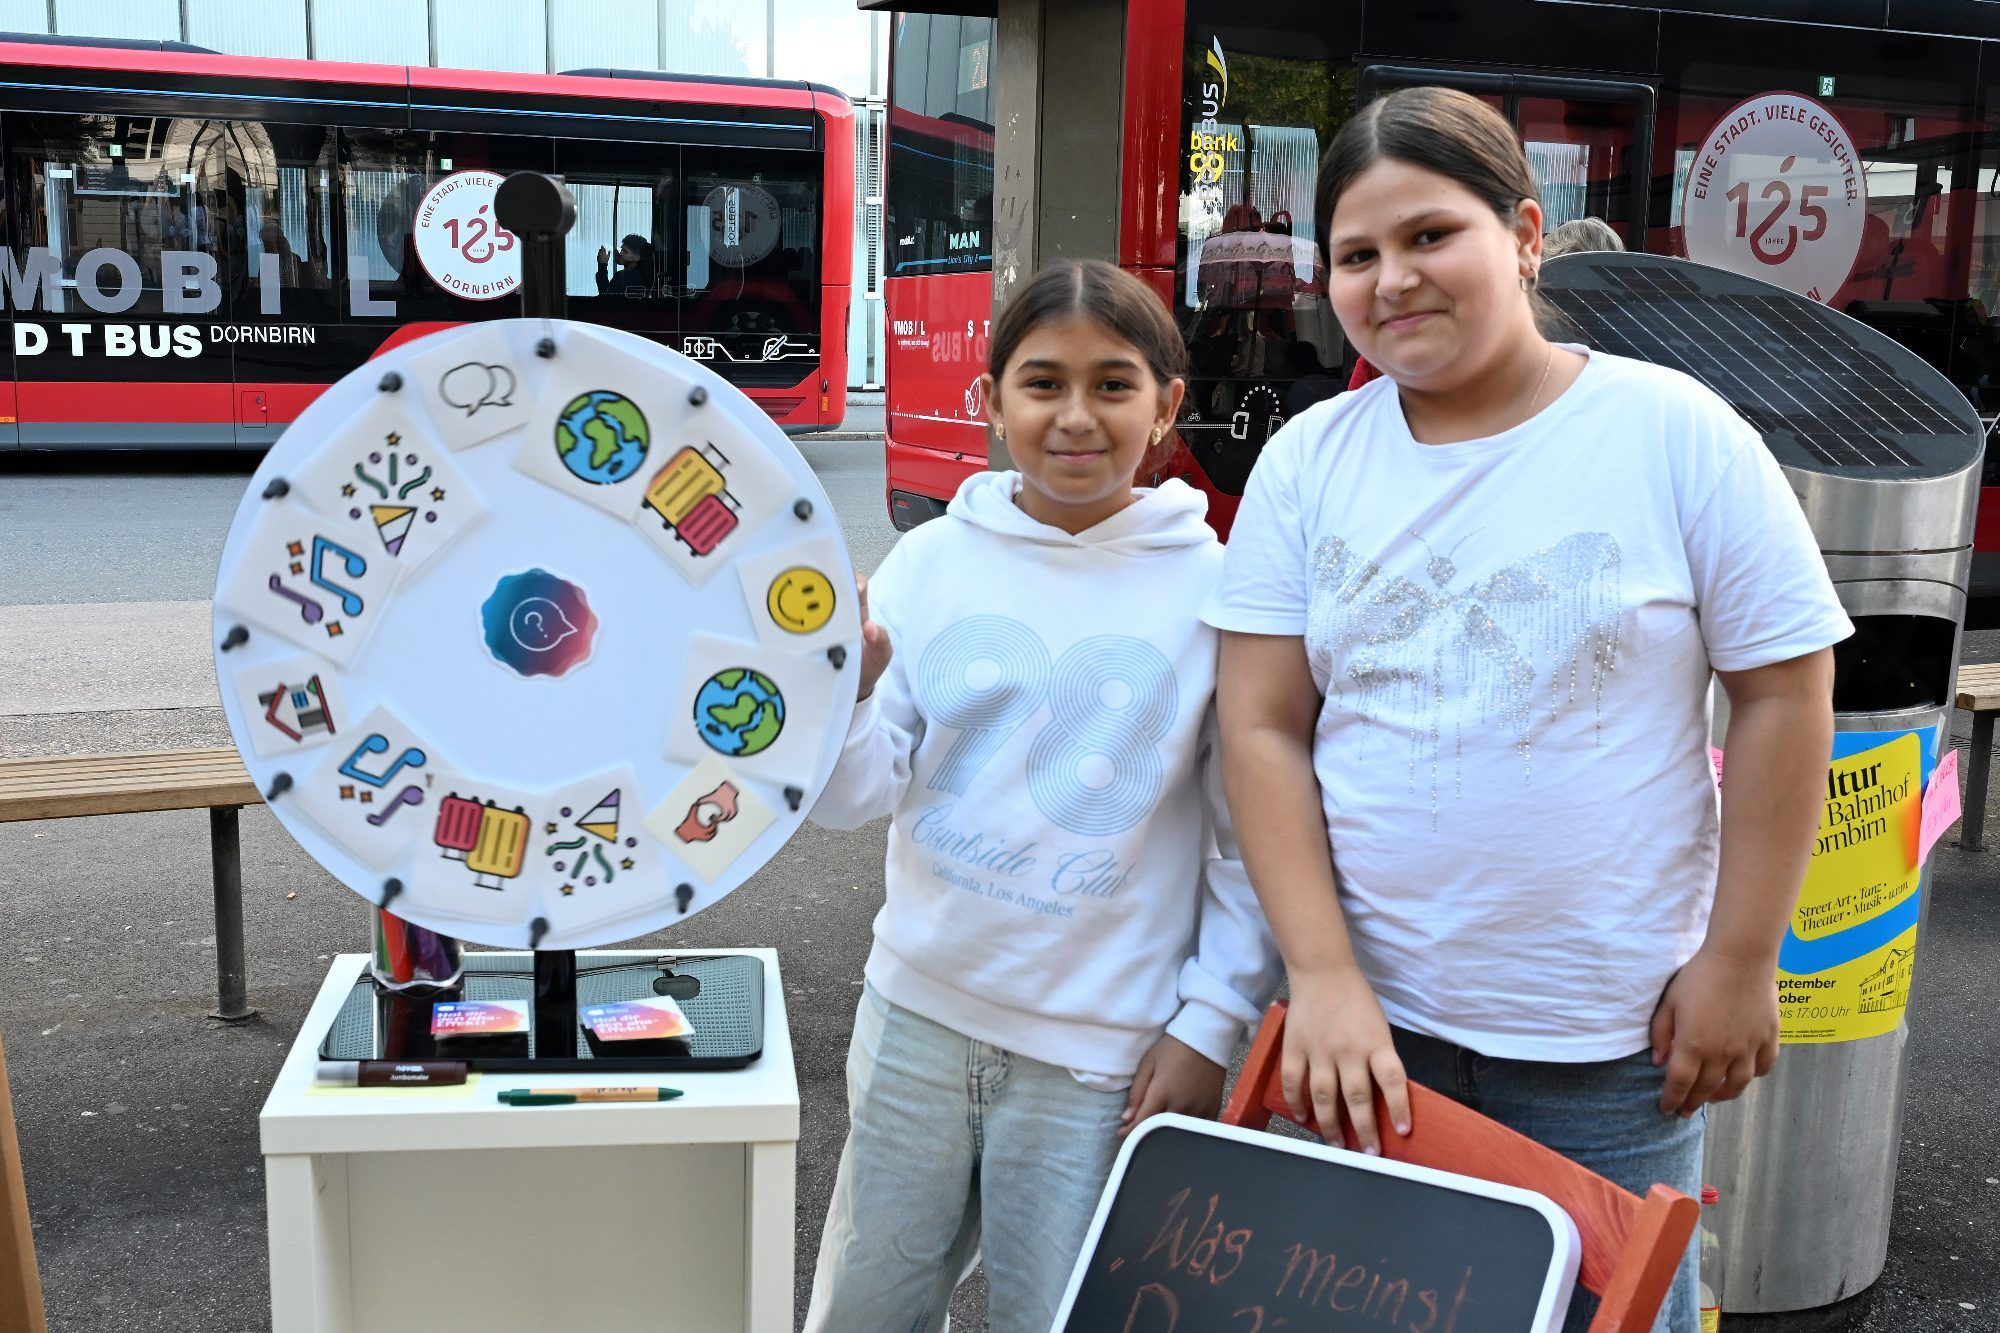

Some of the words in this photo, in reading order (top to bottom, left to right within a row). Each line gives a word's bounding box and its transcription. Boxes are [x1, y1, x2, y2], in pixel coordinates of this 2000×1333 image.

[1190, 130, 1239, 152] bank
[1694, 155, 1718, 200] EINE
[1765, 104, 1807, 124] VIELE
[1809, 115, 1858, 206] GESICHTER.
[421, 203, 436, 228] EINE
[464, 177, 494, 189] VIELE
[443, 217, 515, 264] 125
[949, 230, 980, 250] MAN
[1726, 180, 1829, 266] 125
[442, 273, 515, 295] DORNBIRN
[104, 324, 204, 359] BUS
[210, 325, 317, 345] DORNBIRN
[917, 615, 1179, 837] 98
[1827, 772, 1910, 827] Bahnhof
[911, 804, 1037, 878] Courtside
[1811, 817, 1886, 857] ornbirn
[931, 862, 984, 896] California,
[987, 882, 1013, 902] Los
[1015, 892, 1074, 918] Angeles
[1799, 900, 1832, 919] Street
[1833, 895, 1852, 909] Art
[1860, 883, 1882, 900] Tanz
[1801, 911, 1845, 932] Theater
[1852, 894, 1882, 917] Musik
[1776, 977, 1837, 992] ptember
[1778, 993, 1811, 1004] ober
[1797, 1006, 1829, 1019] 17:00
[1831, 1005, 1850, 1018] Uhr
